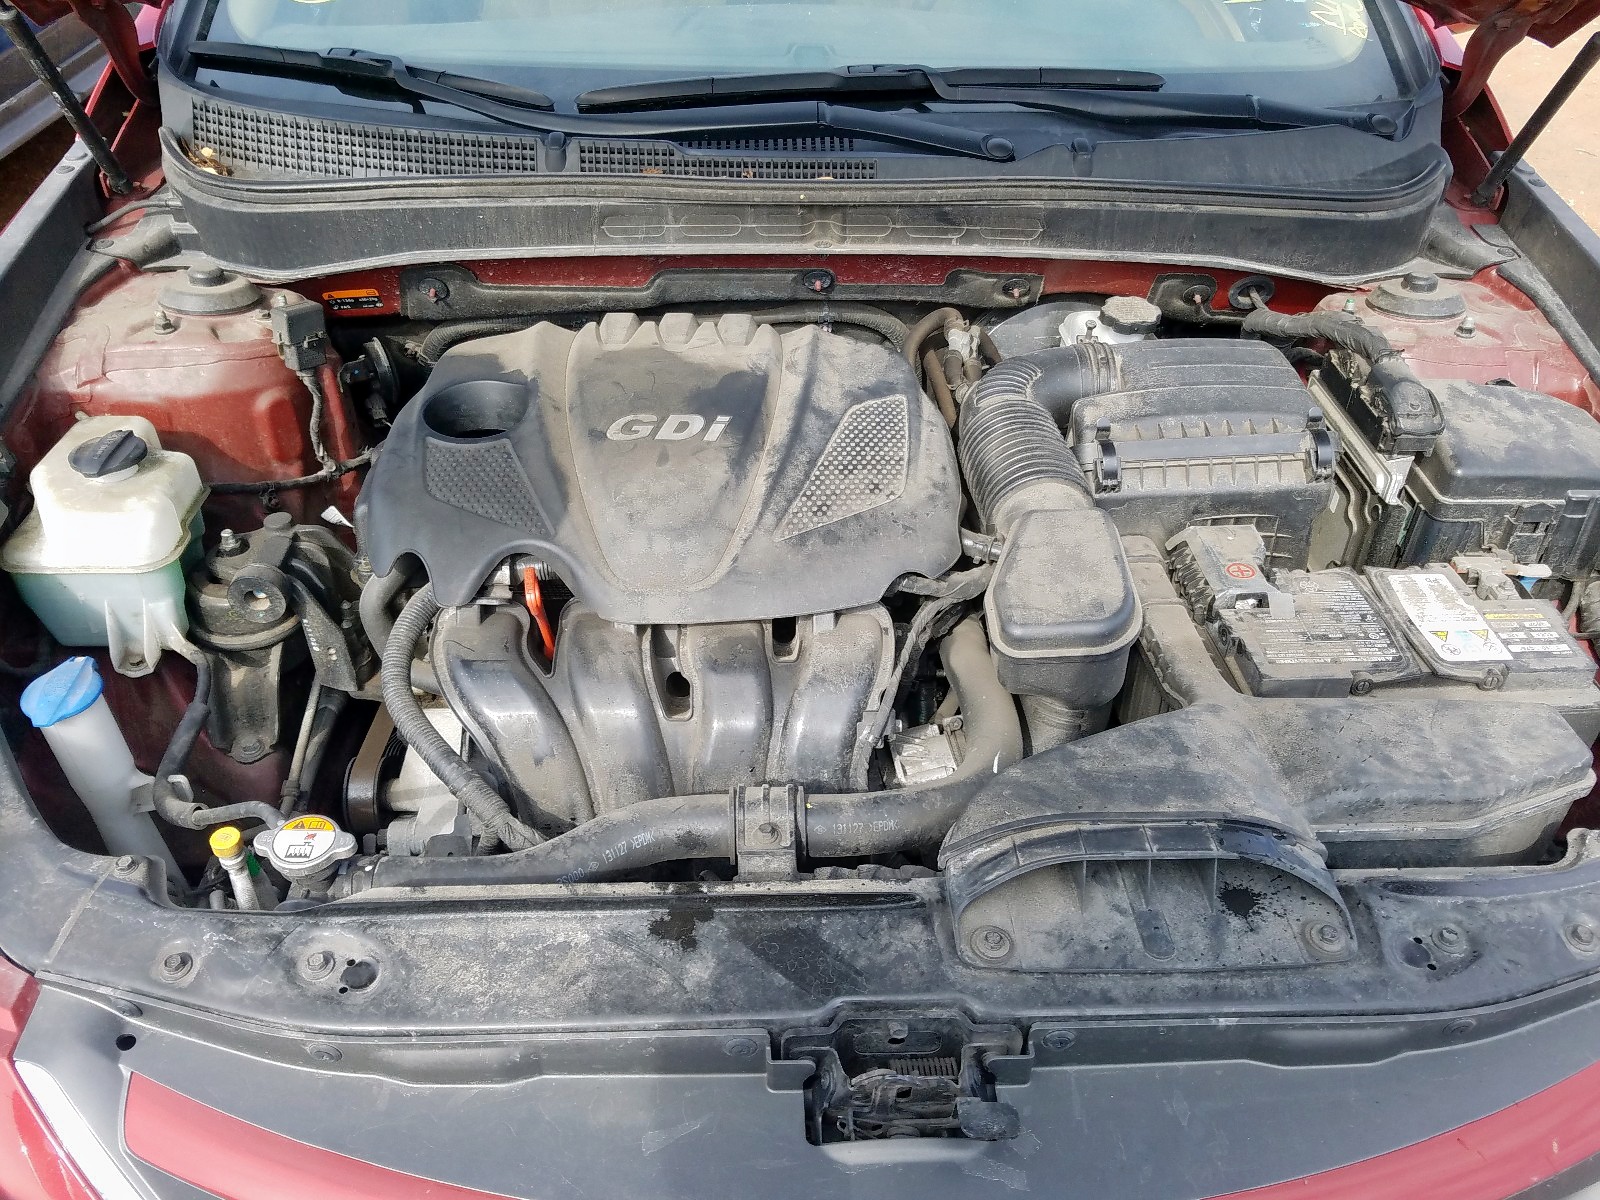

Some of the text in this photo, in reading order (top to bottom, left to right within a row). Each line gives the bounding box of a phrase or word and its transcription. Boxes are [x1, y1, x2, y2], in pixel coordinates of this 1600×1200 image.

[606, 413, 733, 442] GDi
[832, 822, 864, 836] 131127
[602, 840, 628, 865] 131127
